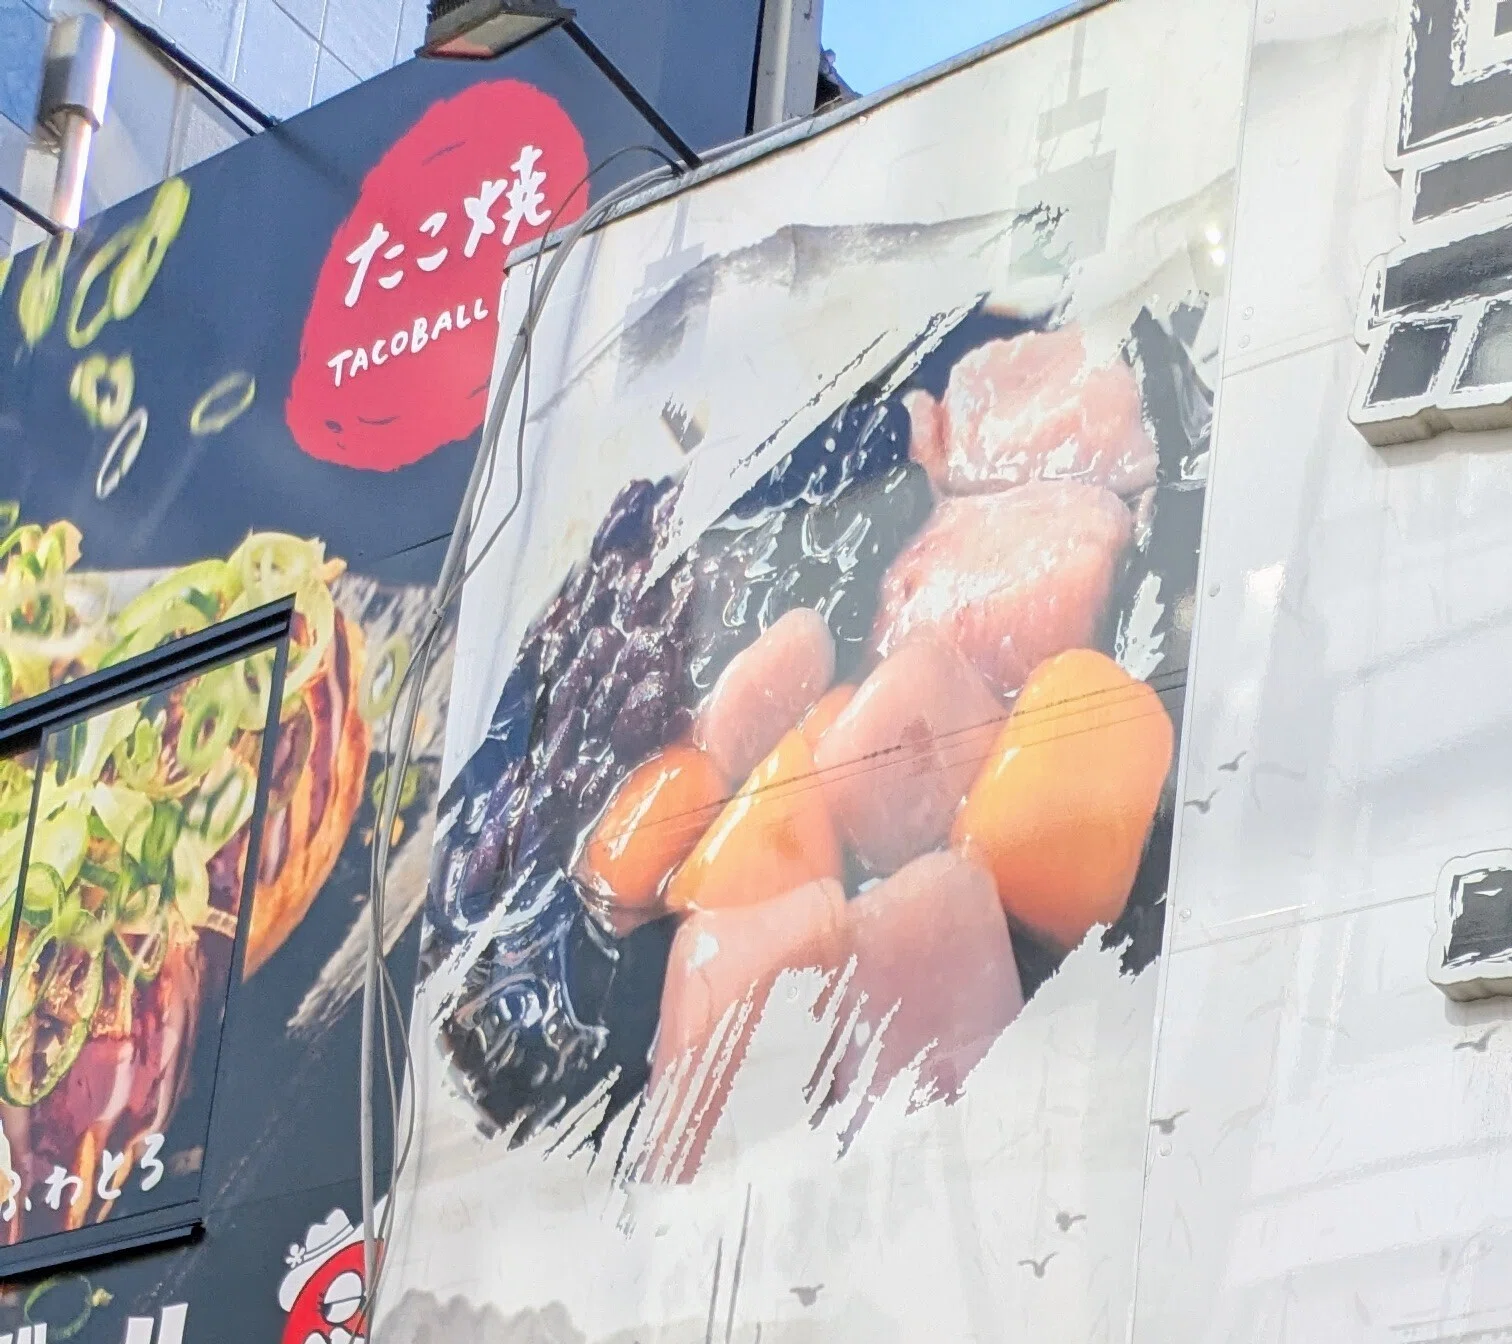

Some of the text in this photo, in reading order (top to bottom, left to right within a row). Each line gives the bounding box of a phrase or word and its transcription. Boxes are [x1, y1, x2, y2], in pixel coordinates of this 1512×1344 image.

[344, 145, 553, 307] たこ焼
[327, 297, 489, 388] TACOBALL
